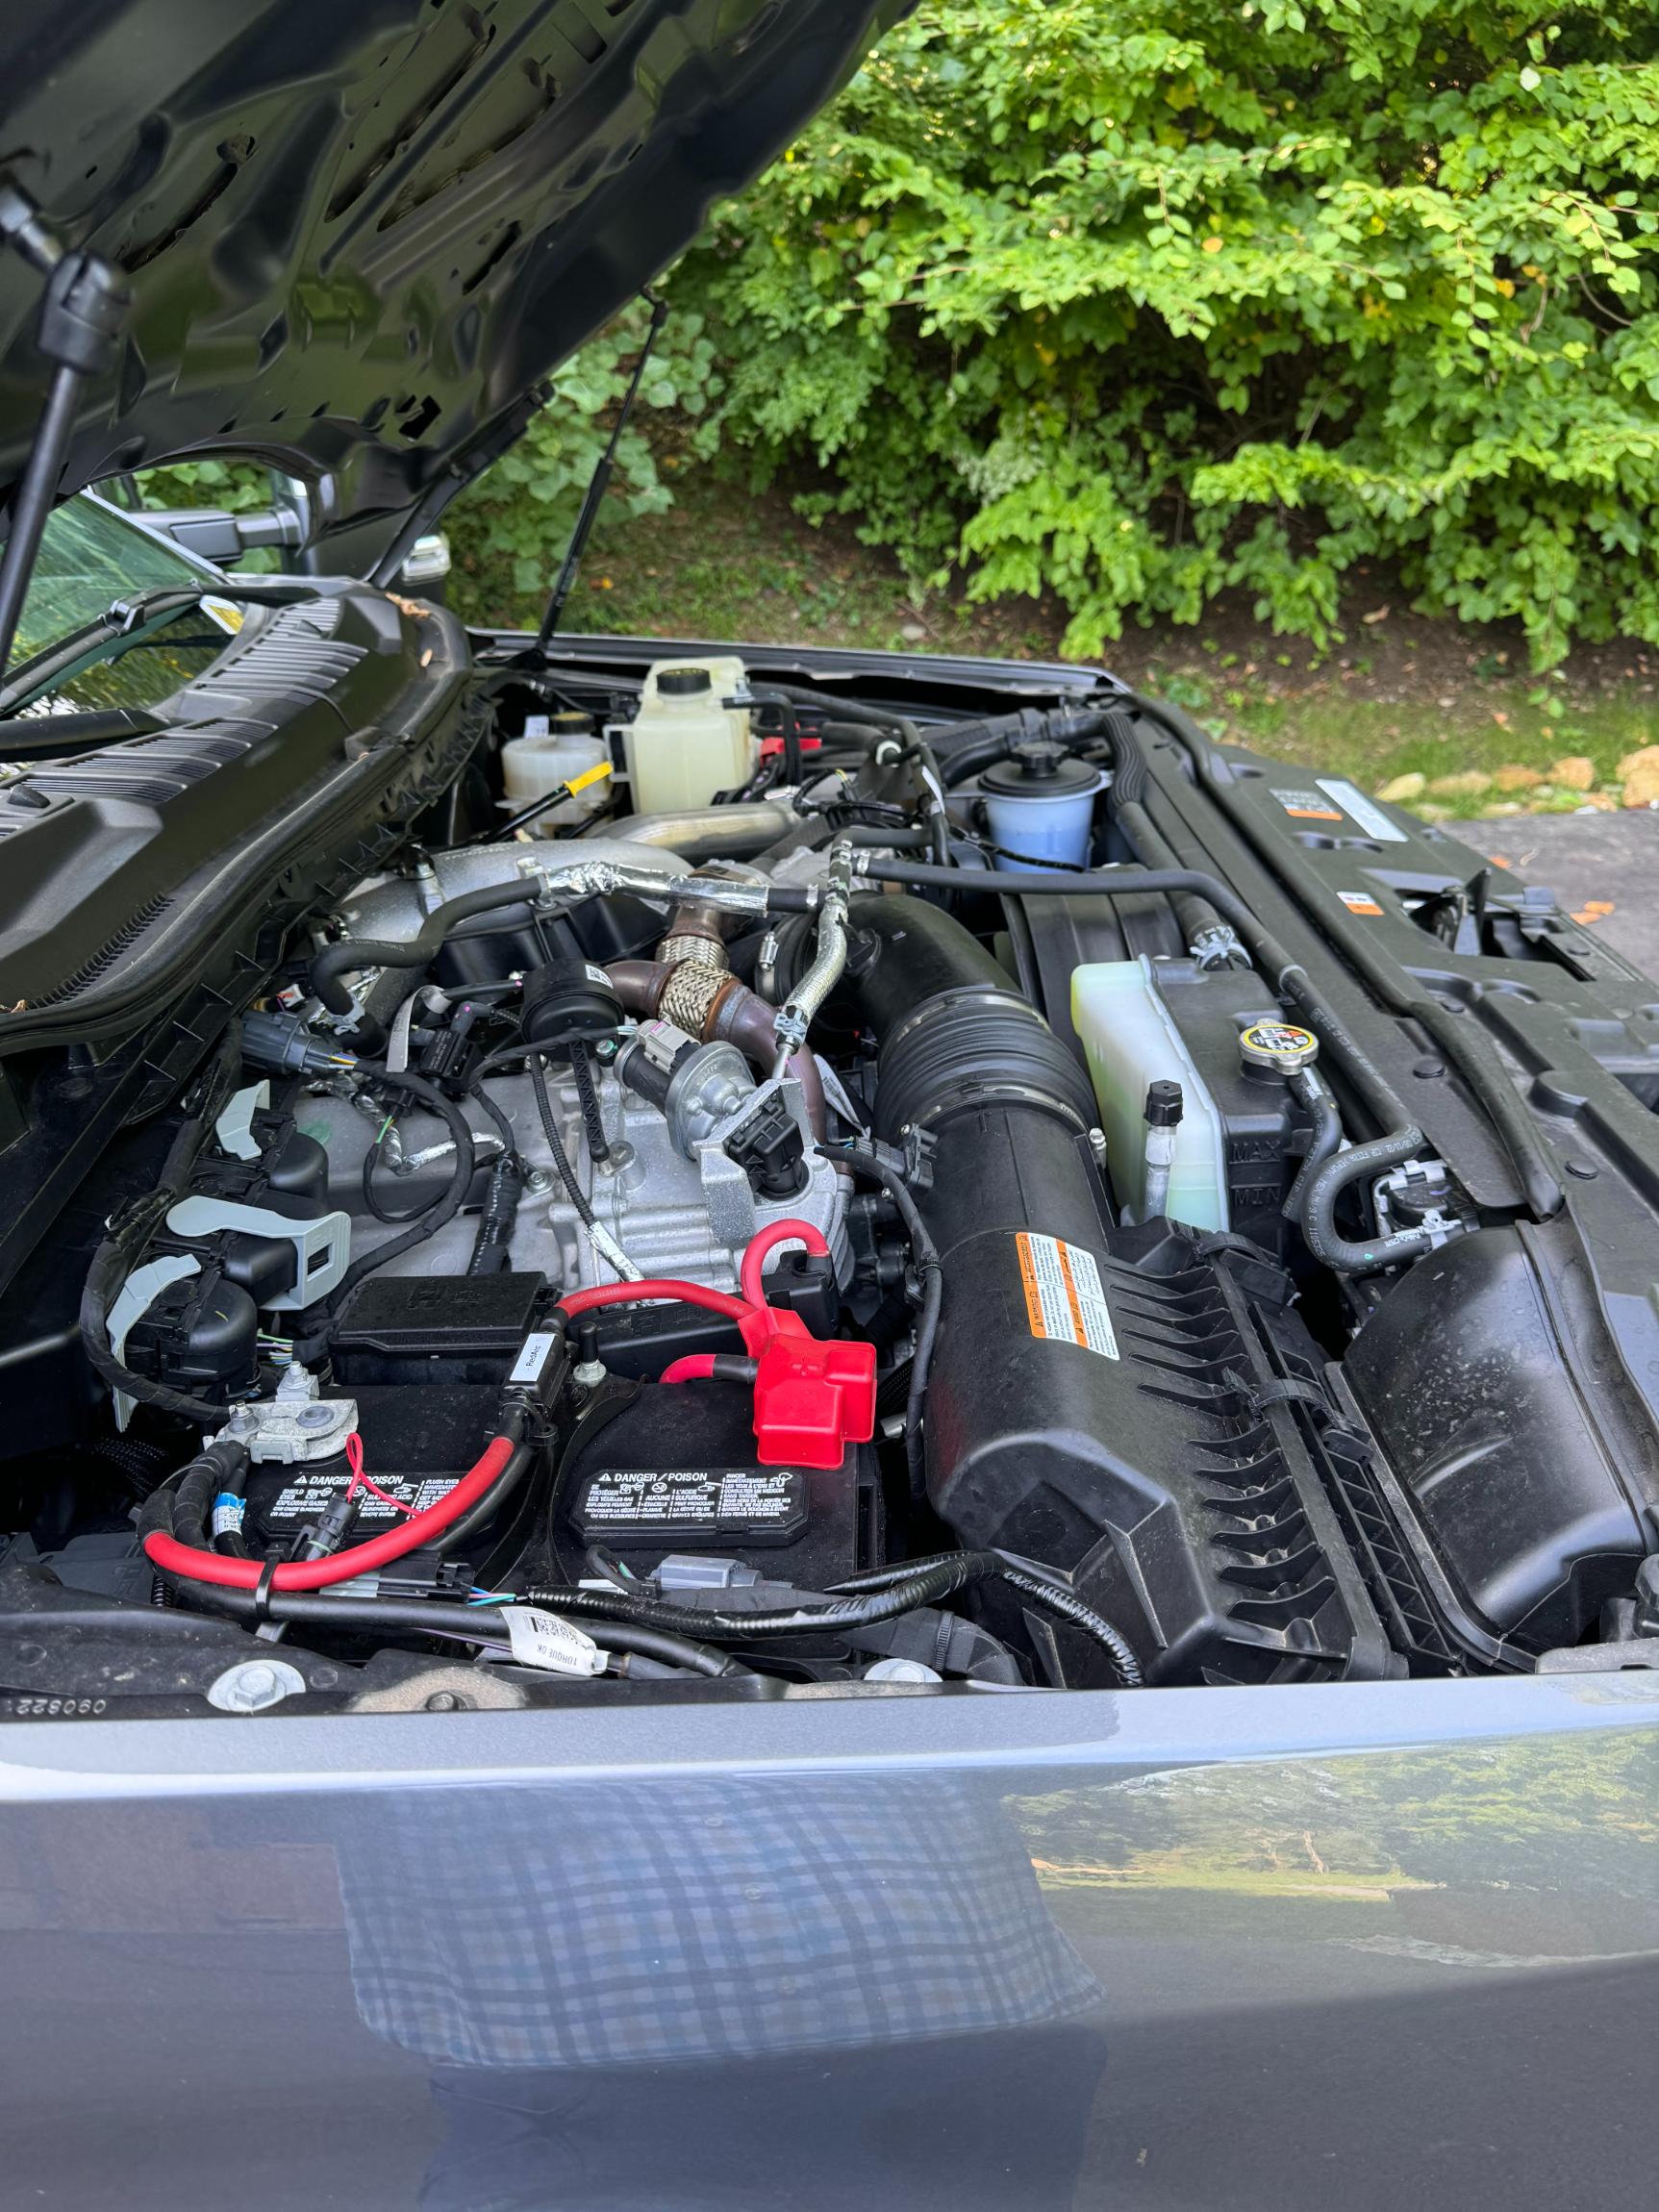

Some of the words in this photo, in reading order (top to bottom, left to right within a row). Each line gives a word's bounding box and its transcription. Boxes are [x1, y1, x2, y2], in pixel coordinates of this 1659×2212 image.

[1233, 1139, 1281, 1162] MAX
[1234, 1186, 1281, 1206] MIN
[309, 1475, 353, 1485] DANGER
[614, 1472, 658, 1482] DANGER
[667, 1472, 708, 1482] POISON
[537, 1643, 547, 1654] OK
[548, 1646, 578, 1667] TORQUE
